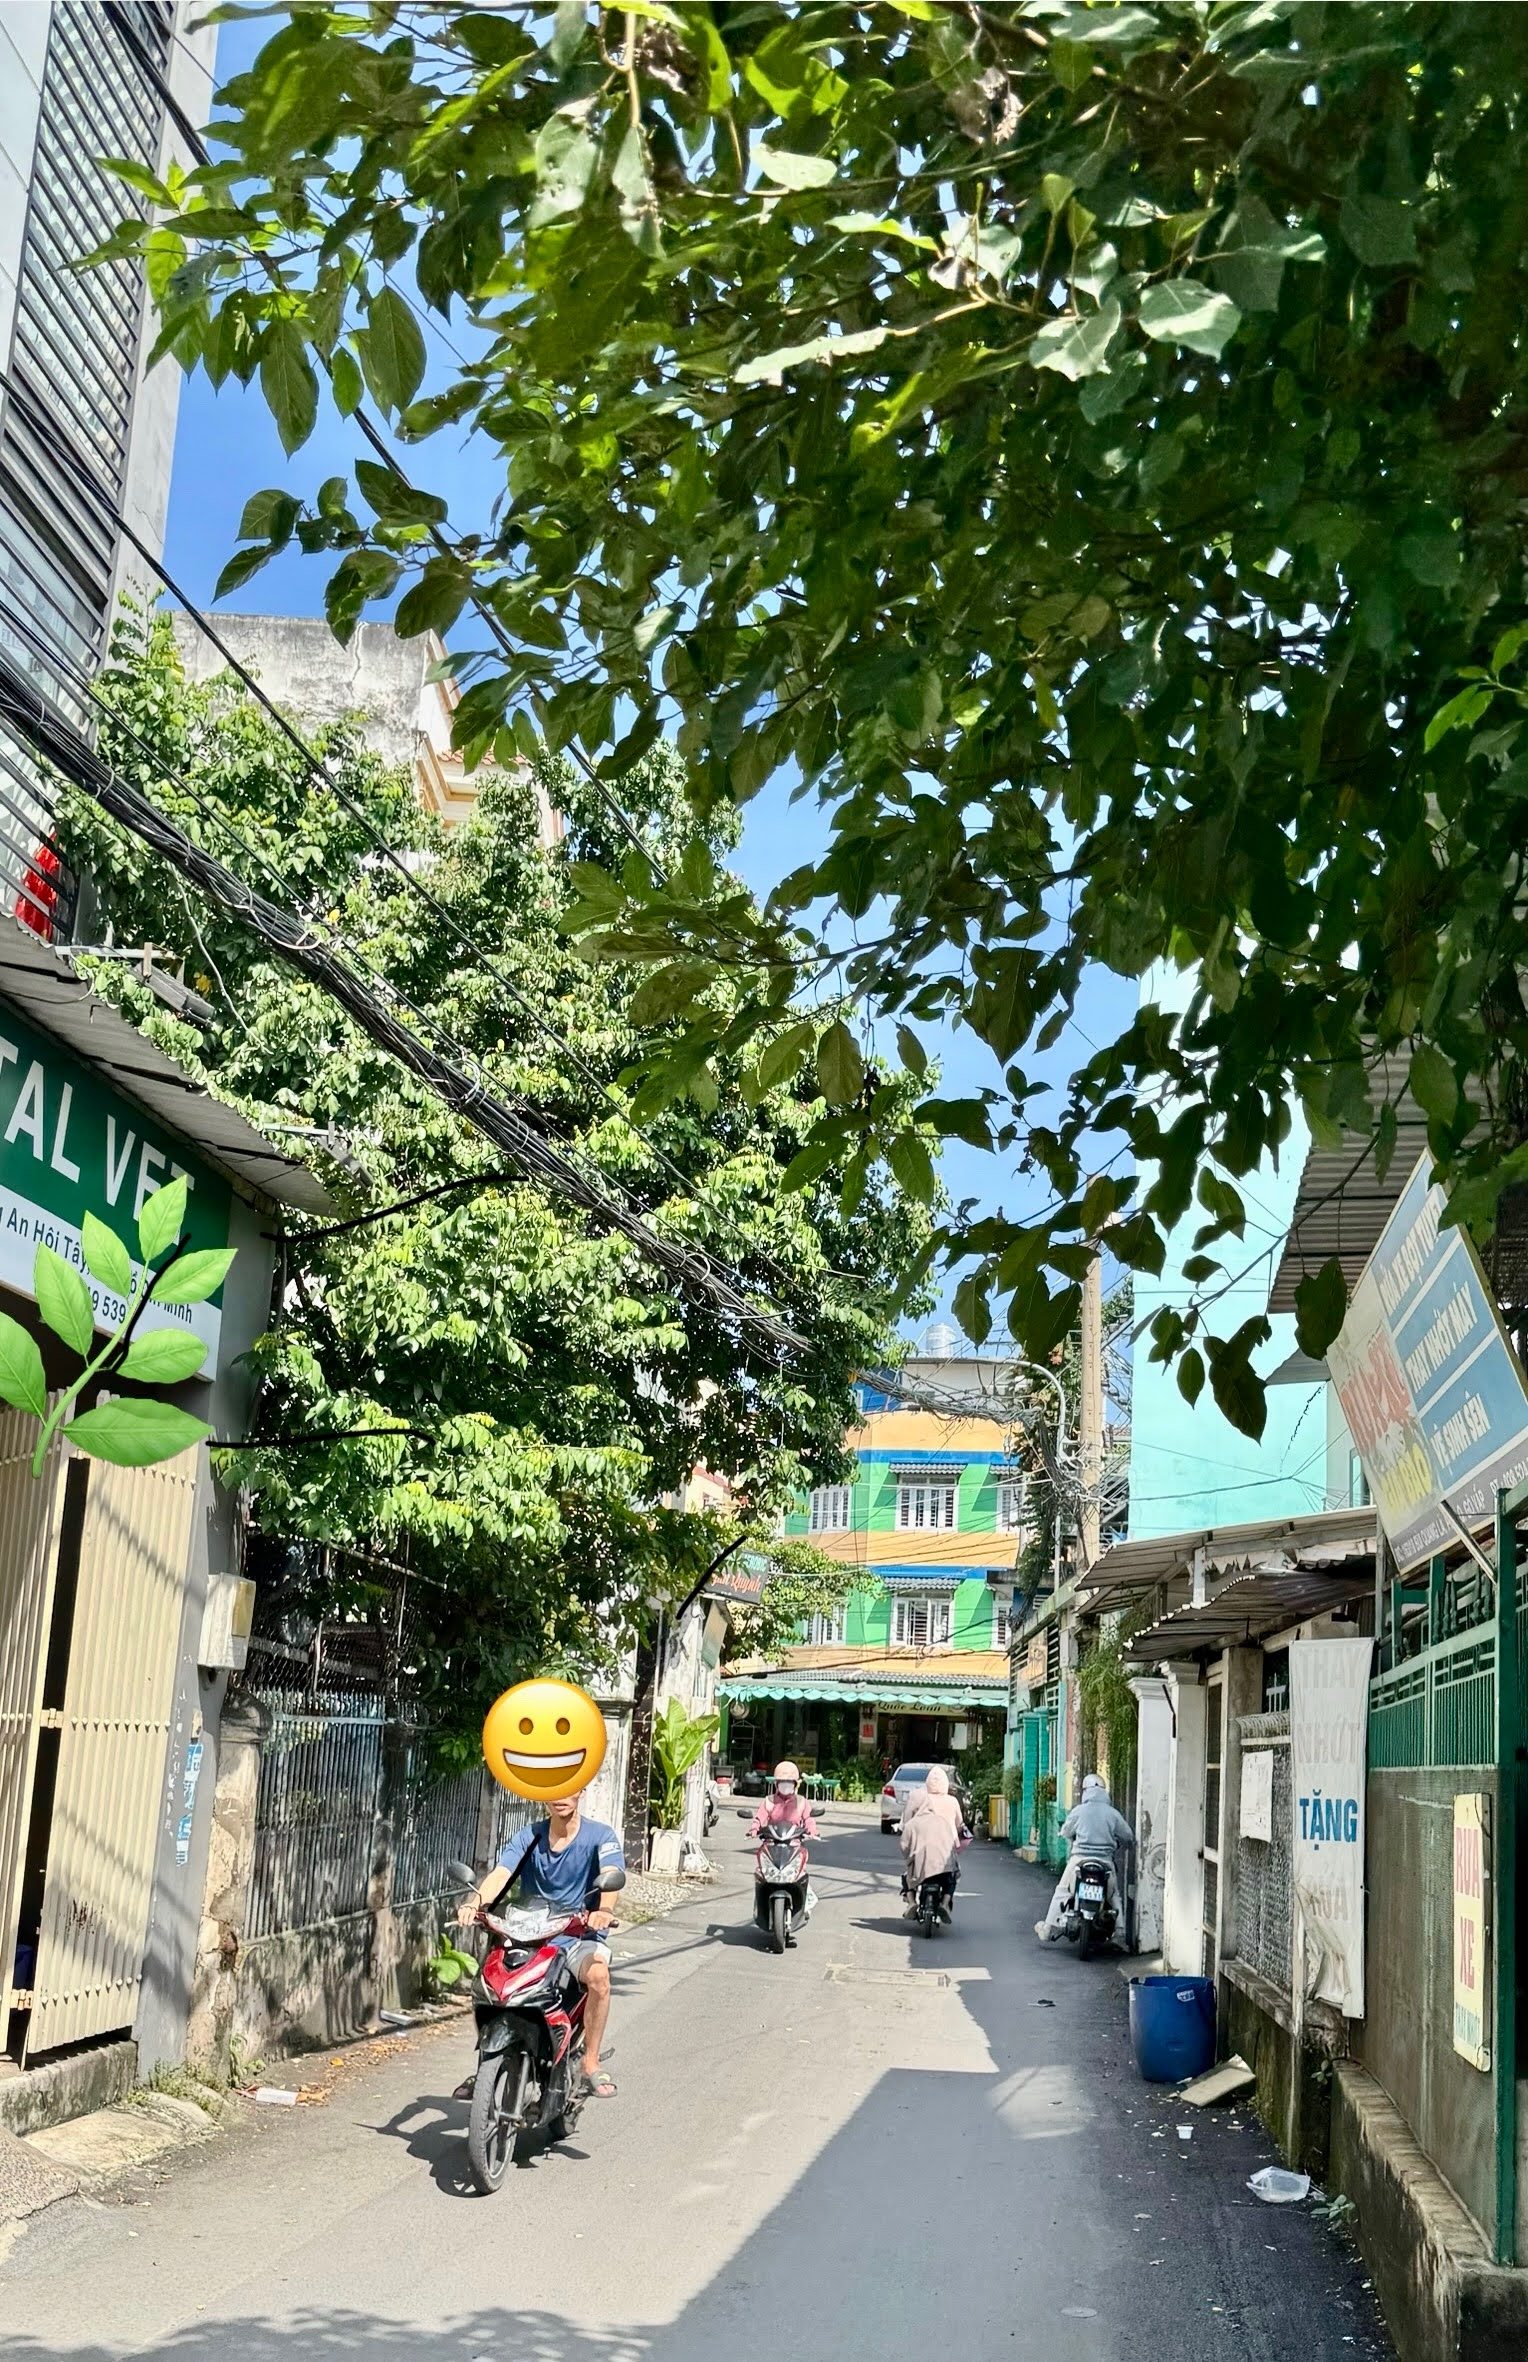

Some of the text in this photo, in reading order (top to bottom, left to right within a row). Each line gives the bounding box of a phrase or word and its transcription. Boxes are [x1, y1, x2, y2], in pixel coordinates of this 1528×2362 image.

[7, 1207, 29, 1238] An
[1391, 1251, 1410, 1296] XE
[1405, 1340, 1432, 1393] THAY
[1447, 1279, 1478, 1342] MÁY
[1430, 1390, 1491, 1476] VỆ SINH SÊN
[1299, 1788, 1358, 1851] TẶNG
[1459, 1916, 1475, 1990] XE
